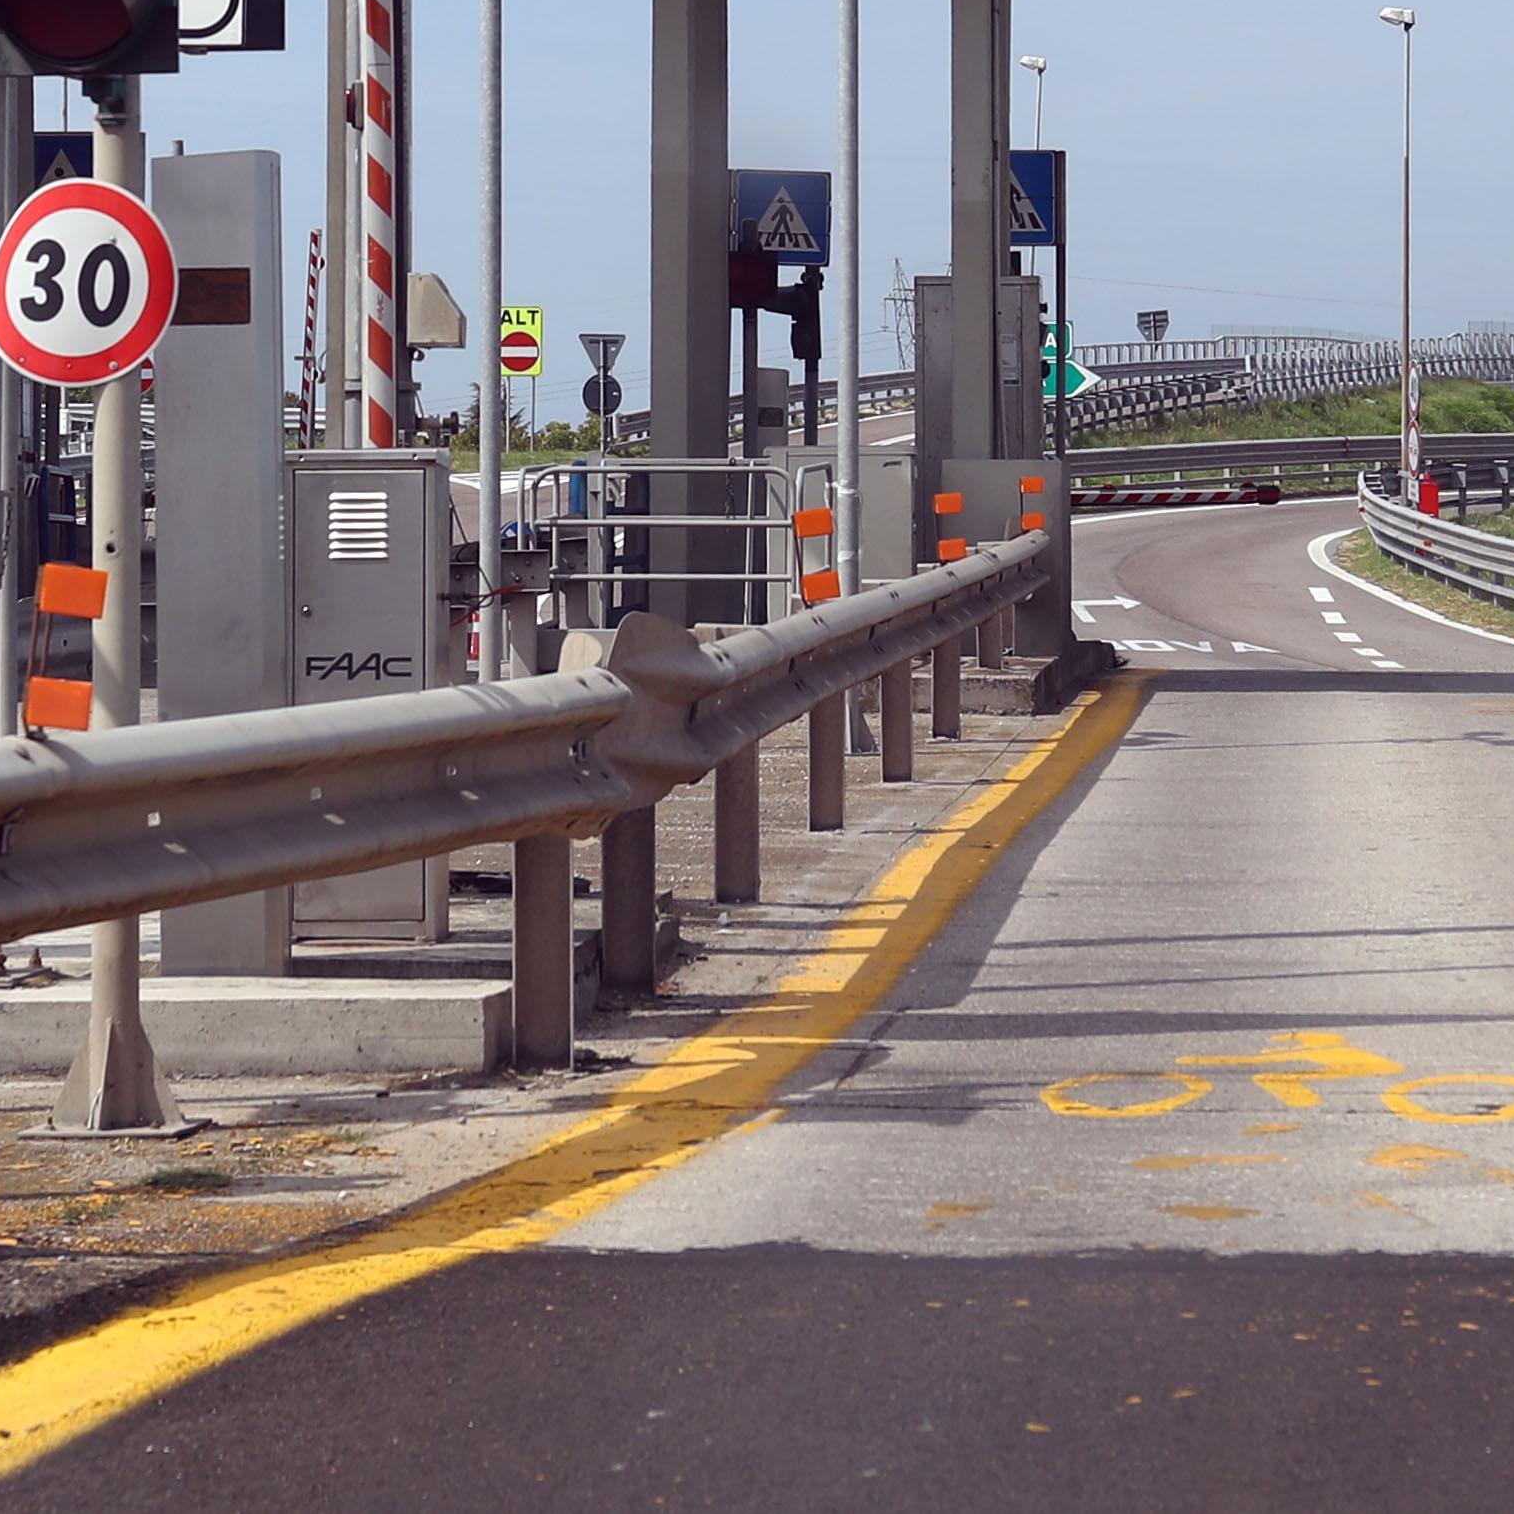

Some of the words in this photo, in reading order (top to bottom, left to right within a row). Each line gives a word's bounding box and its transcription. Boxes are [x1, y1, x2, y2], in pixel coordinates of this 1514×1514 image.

[19, 238, 131, 328] 30
[501, 309, 540, 326] ALT
[305, 652, 413, 681] FAAC
